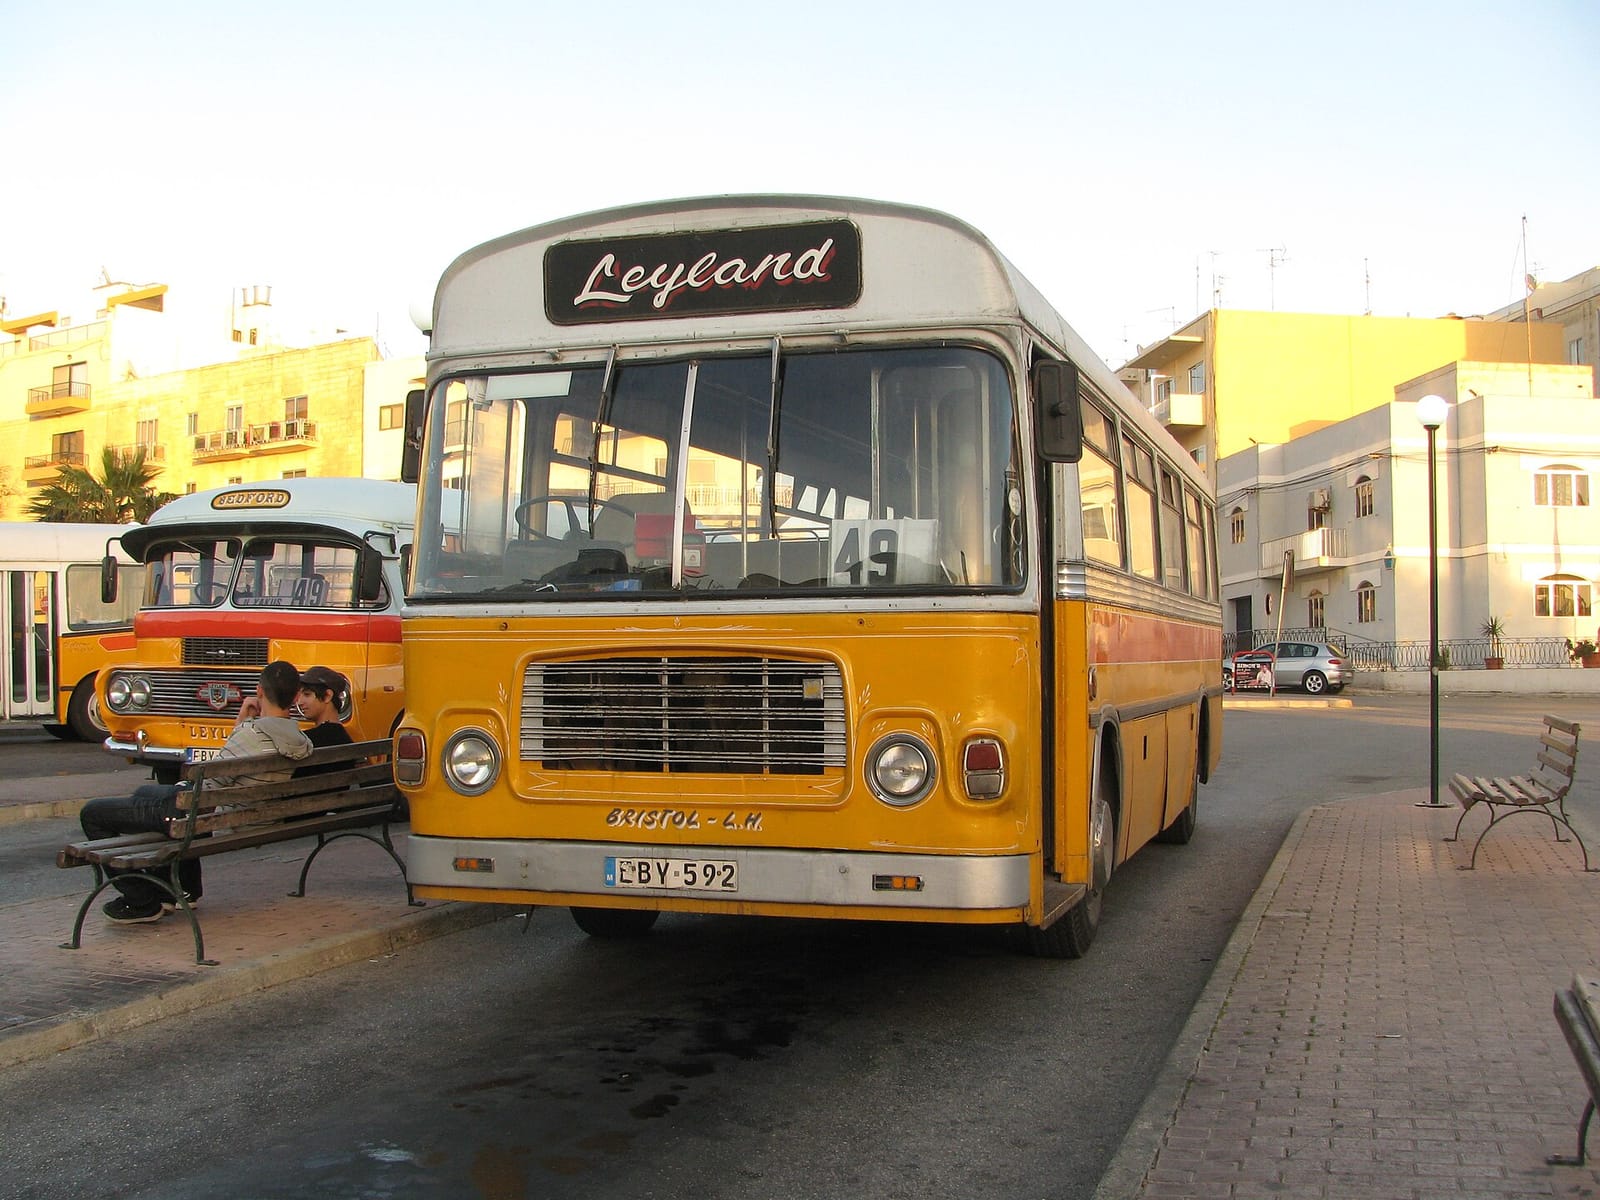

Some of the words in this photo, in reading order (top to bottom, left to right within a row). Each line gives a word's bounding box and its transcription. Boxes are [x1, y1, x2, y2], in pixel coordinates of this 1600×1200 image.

[573, 238, 835, 309] Leyland
[218, 493, 285, 505] BEDFORD
[835, 527, 900, 586] 49
[294, 579, 325, 606] 49
[190, 726, 233, 740] LEYL
[606, 807, 701, 830] BRISTOL
